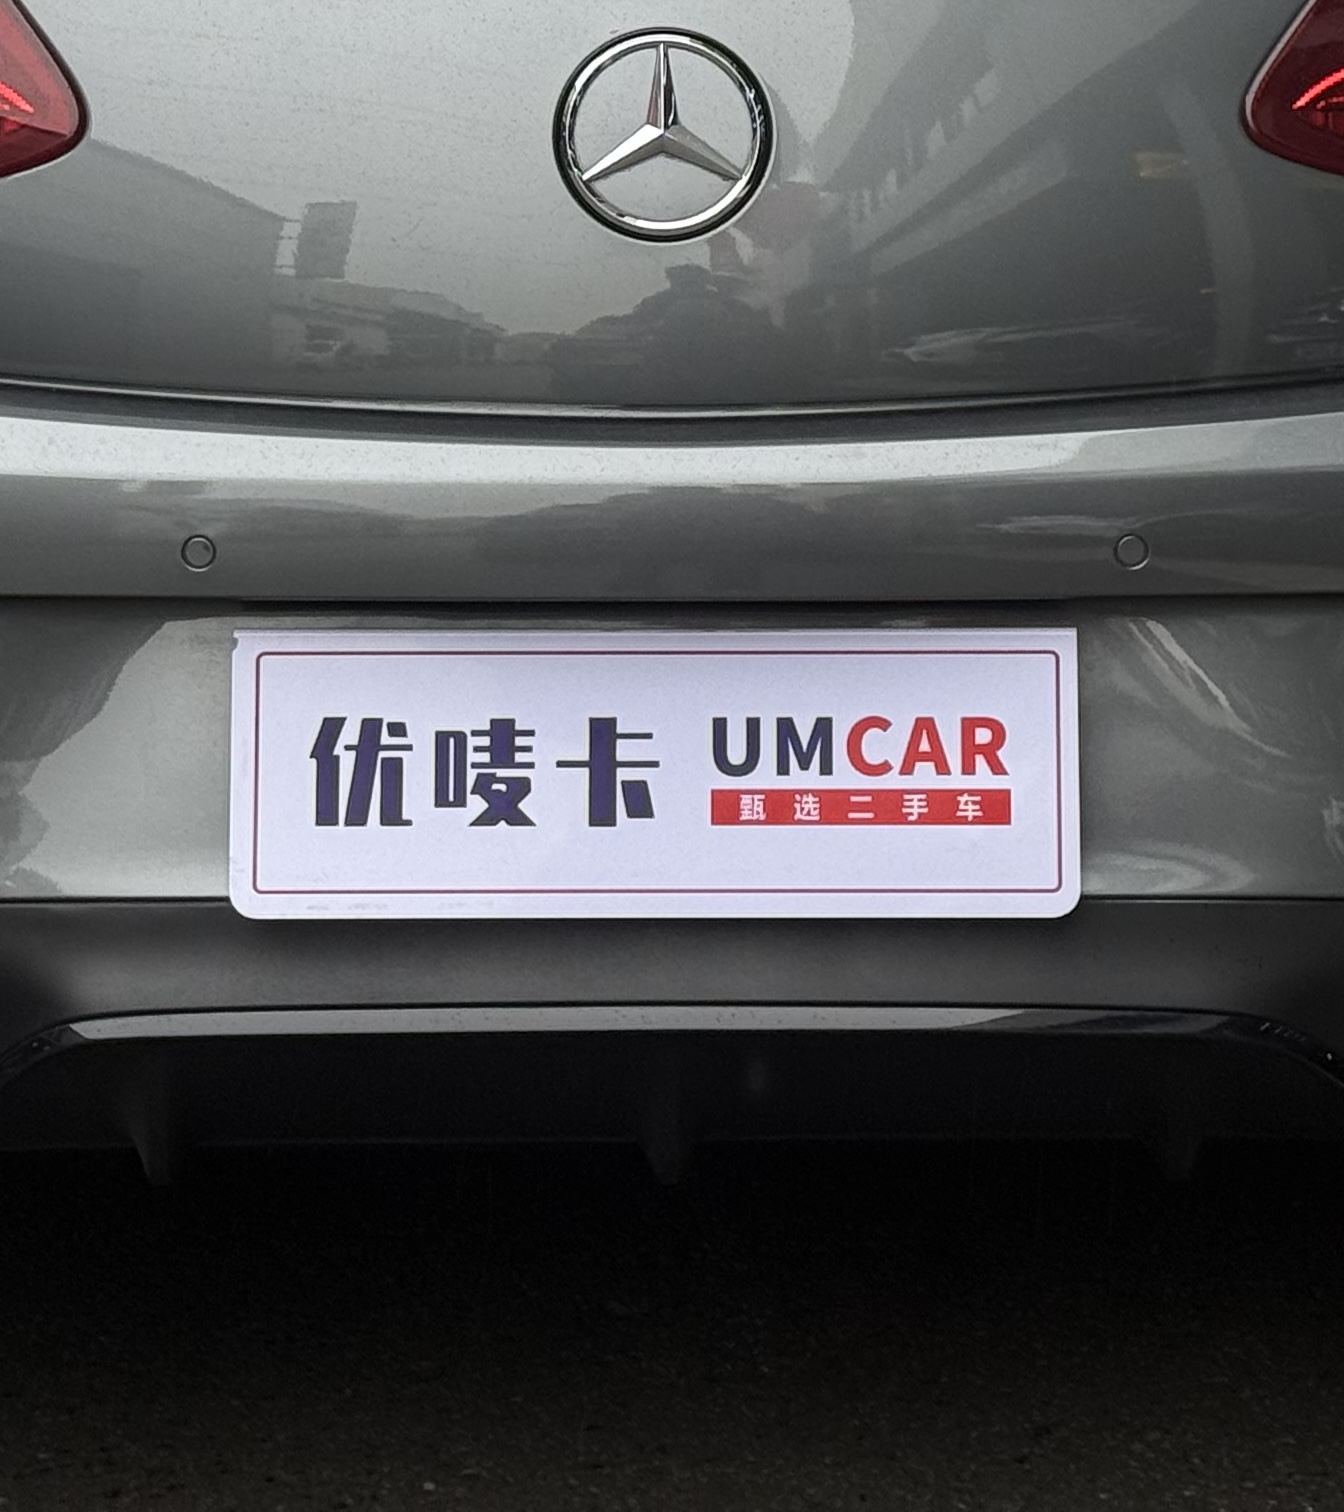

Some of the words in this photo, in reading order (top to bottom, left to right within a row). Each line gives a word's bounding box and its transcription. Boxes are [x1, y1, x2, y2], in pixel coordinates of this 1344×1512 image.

[309, 715, 661, 828] 优唛卡
[711, 715, 1011, 778] UMCAR
[737, 791, 986, 823] 甄选二手车
